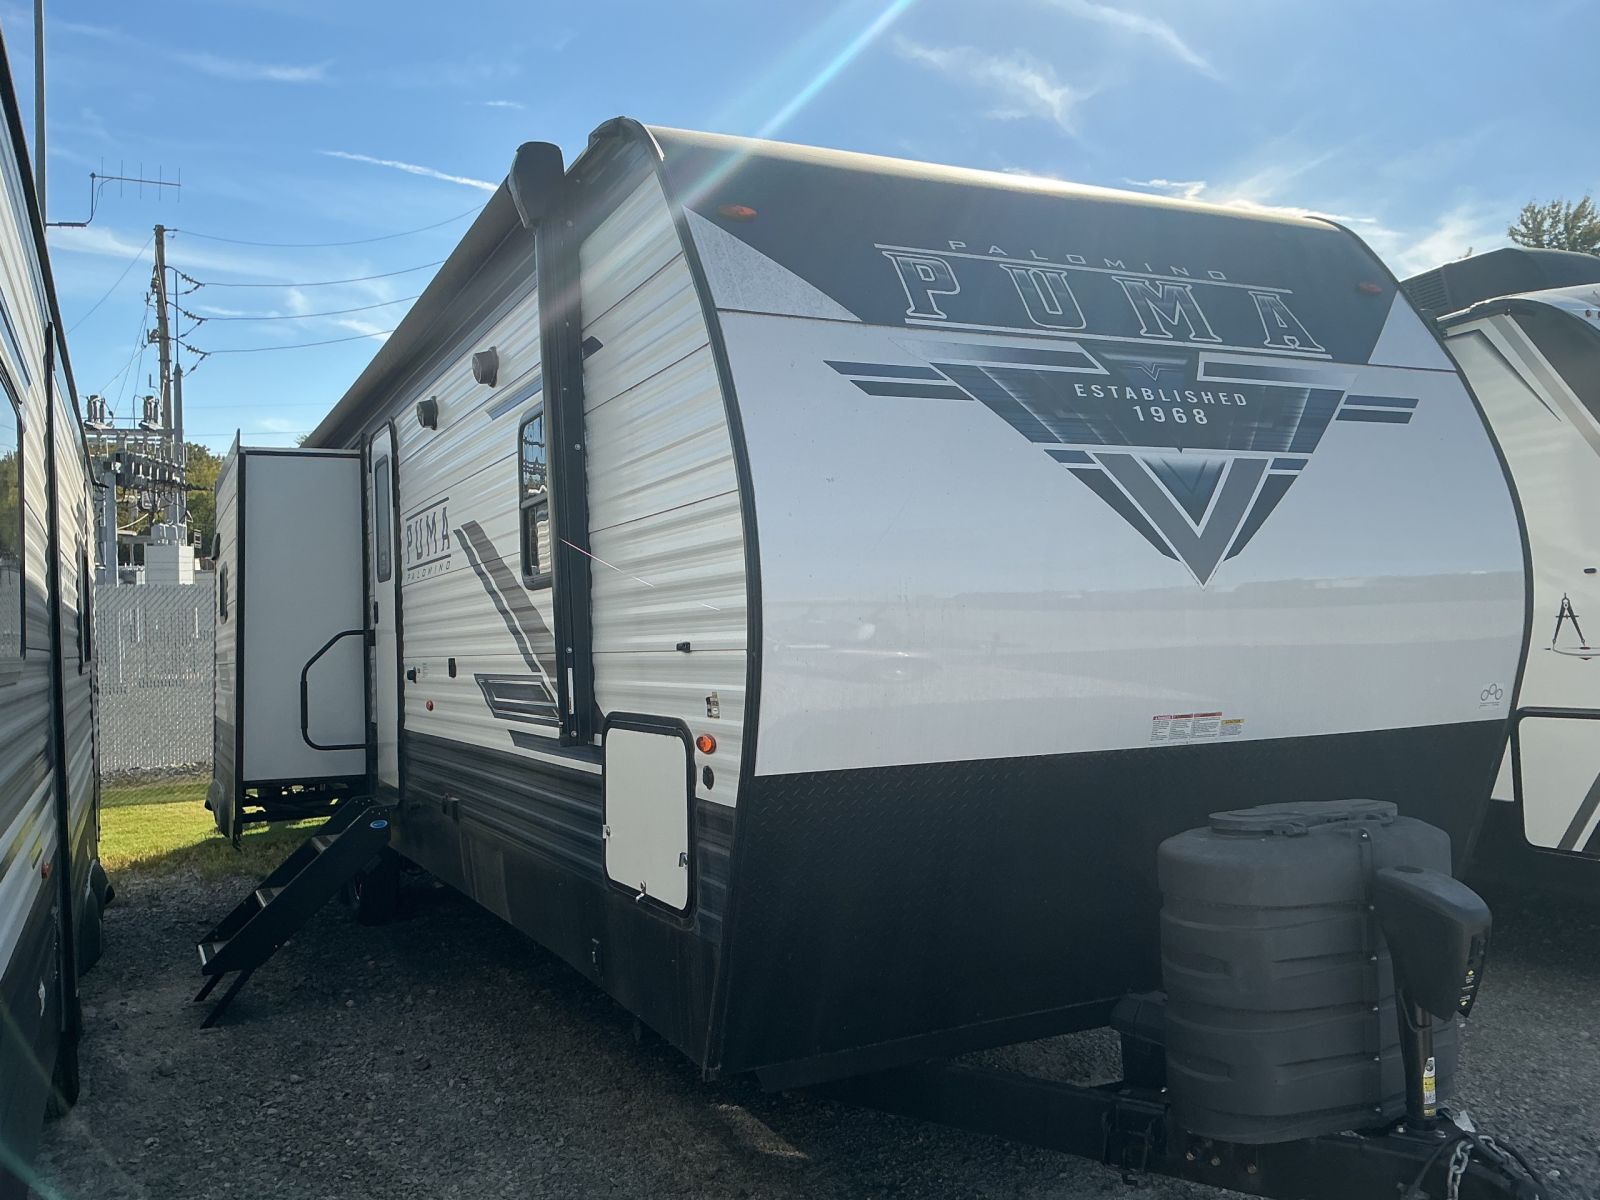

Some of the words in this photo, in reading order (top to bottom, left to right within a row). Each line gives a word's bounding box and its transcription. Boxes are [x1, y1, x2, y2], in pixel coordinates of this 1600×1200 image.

[947, 240, 1228, 281] PALOMINO
[881, 250, 1327, 353] PUMA
[1074, 382, 1249, 407] ESTABLISHED
[1132, 404, 1209, 426] 1968
[406, 506, 451, 565] PUMA
[406, 560, 451, 581] PALOMINO
